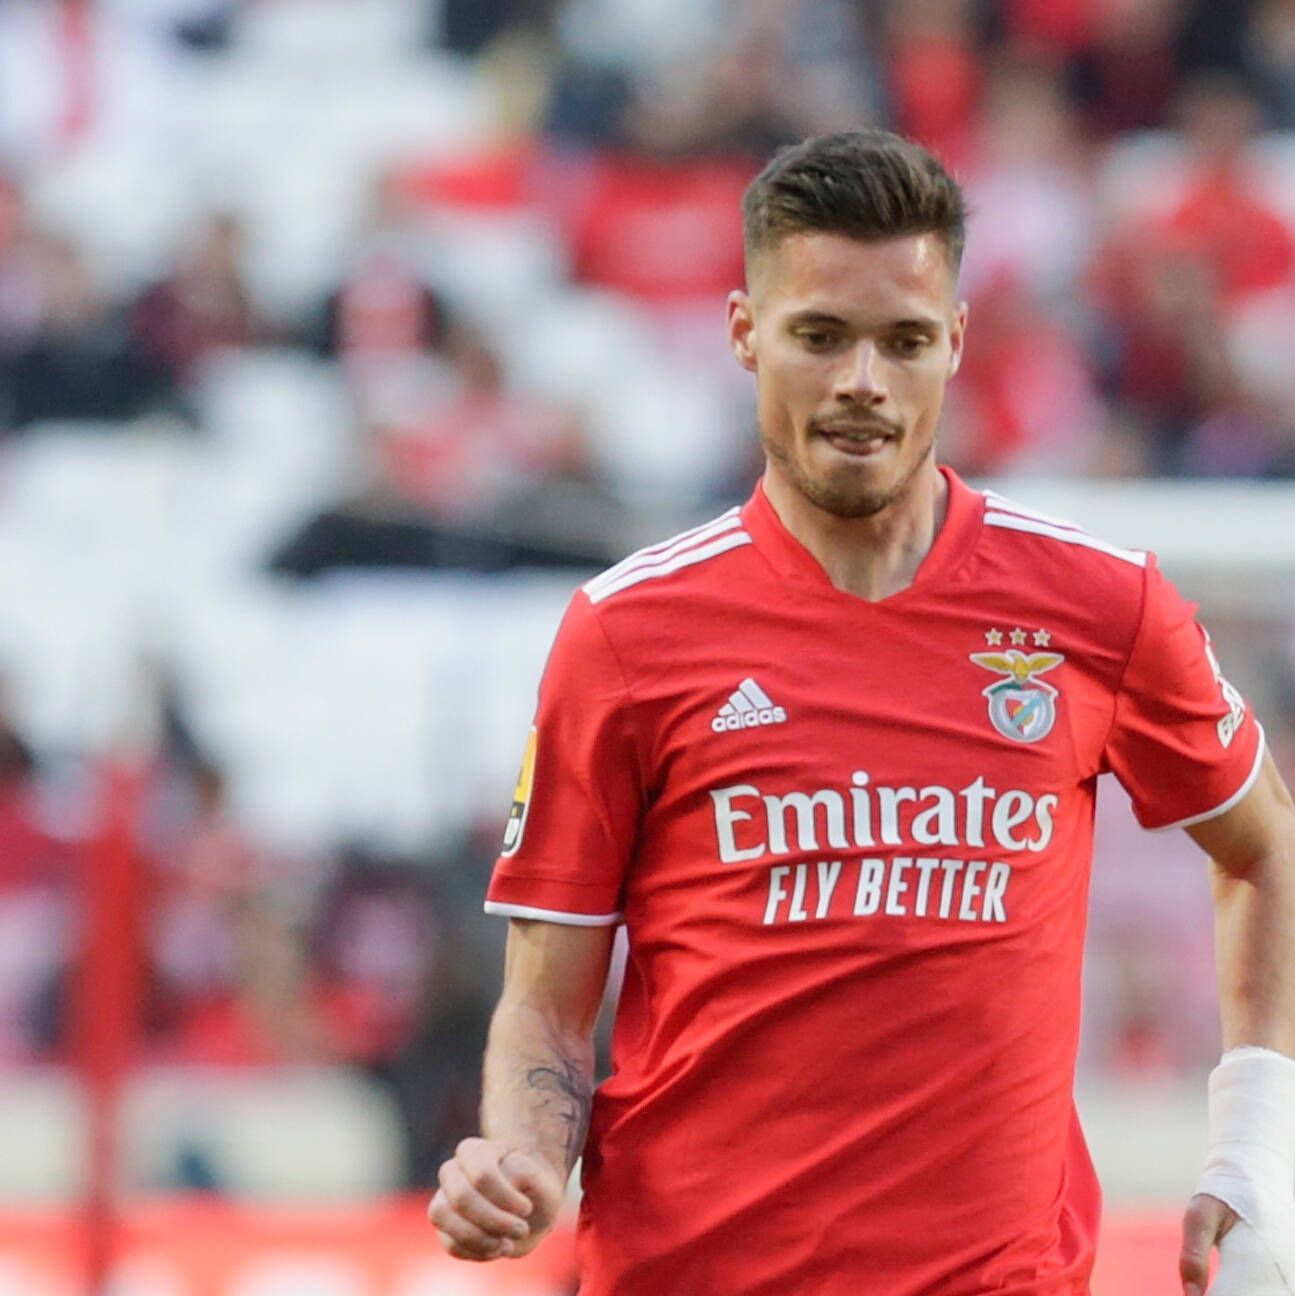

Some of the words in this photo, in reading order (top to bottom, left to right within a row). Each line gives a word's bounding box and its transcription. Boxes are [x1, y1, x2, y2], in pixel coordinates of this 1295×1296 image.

[711, 706, 787, 732] adidas
[710, 770, 1058, 863] Emirates
[763, 861, 842, 925] FLY
[853, 857, 1010, 922] BETTER
